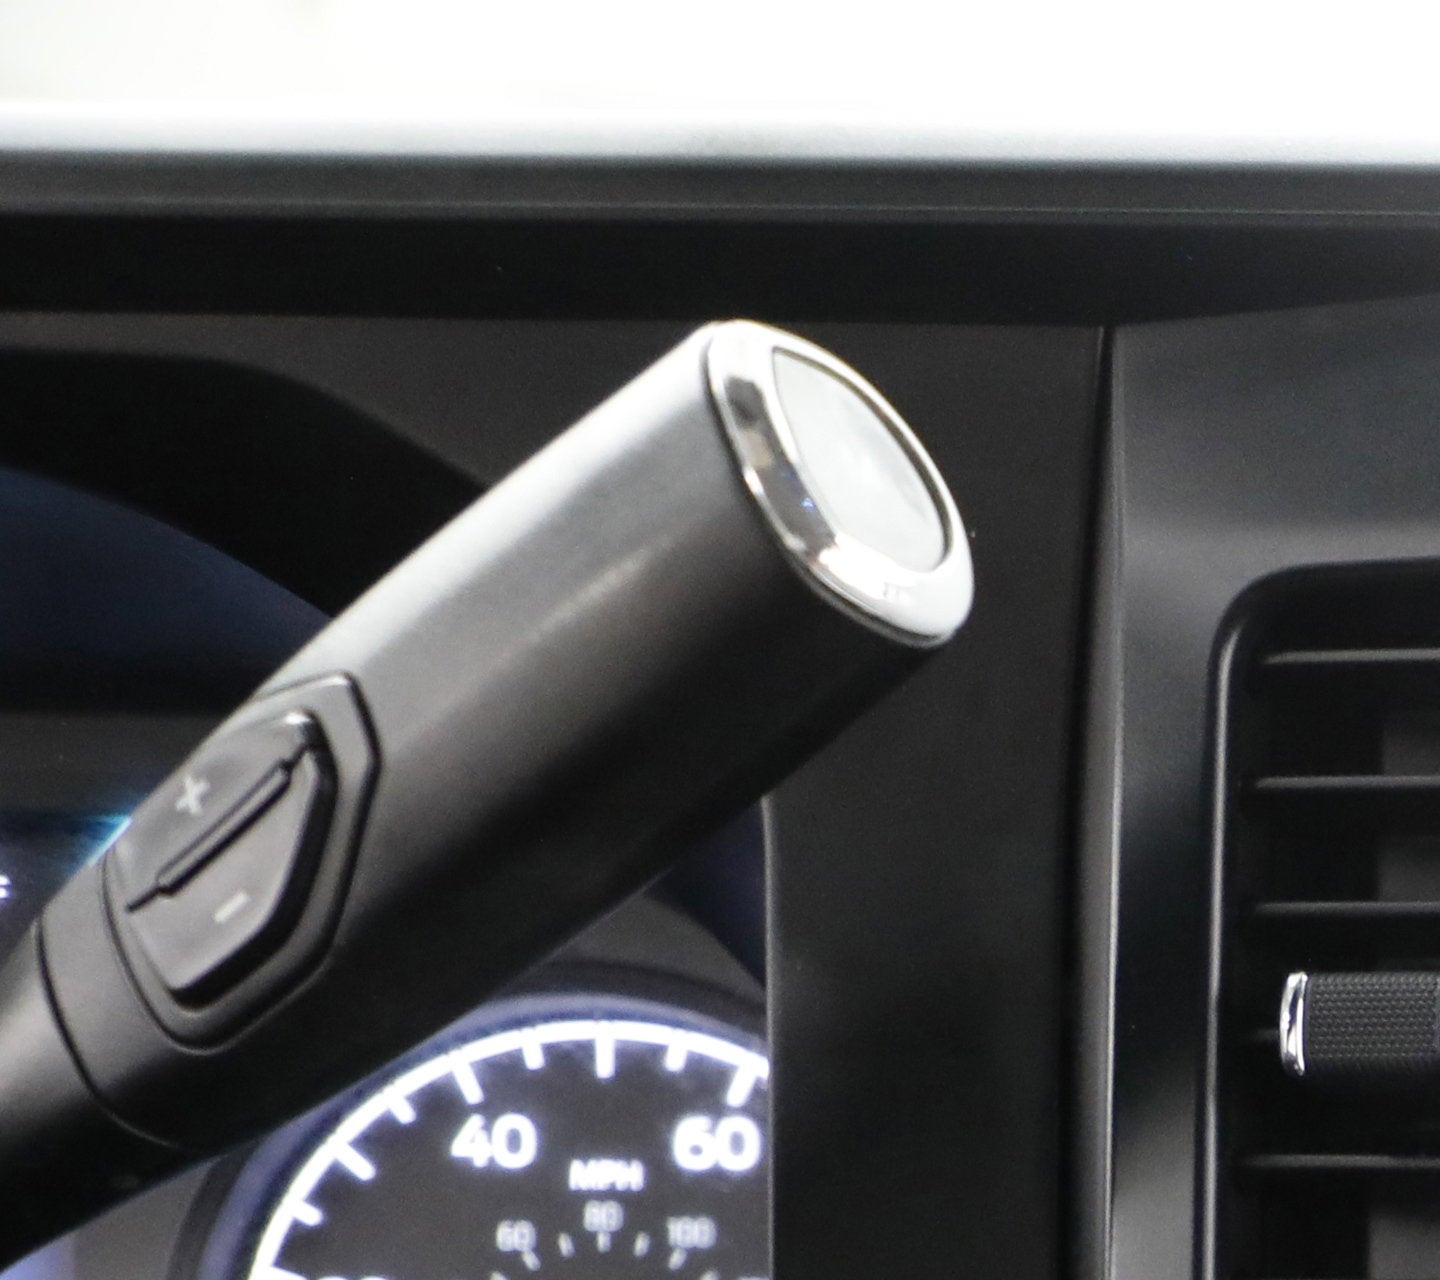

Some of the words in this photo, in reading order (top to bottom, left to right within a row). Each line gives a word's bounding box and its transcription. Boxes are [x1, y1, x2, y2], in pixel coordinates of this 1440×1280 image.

[450, 1114, 537, 1169] 40
[672, 1115, 761, 1172] 60
[569, 1159, 644, 1191] MPH
